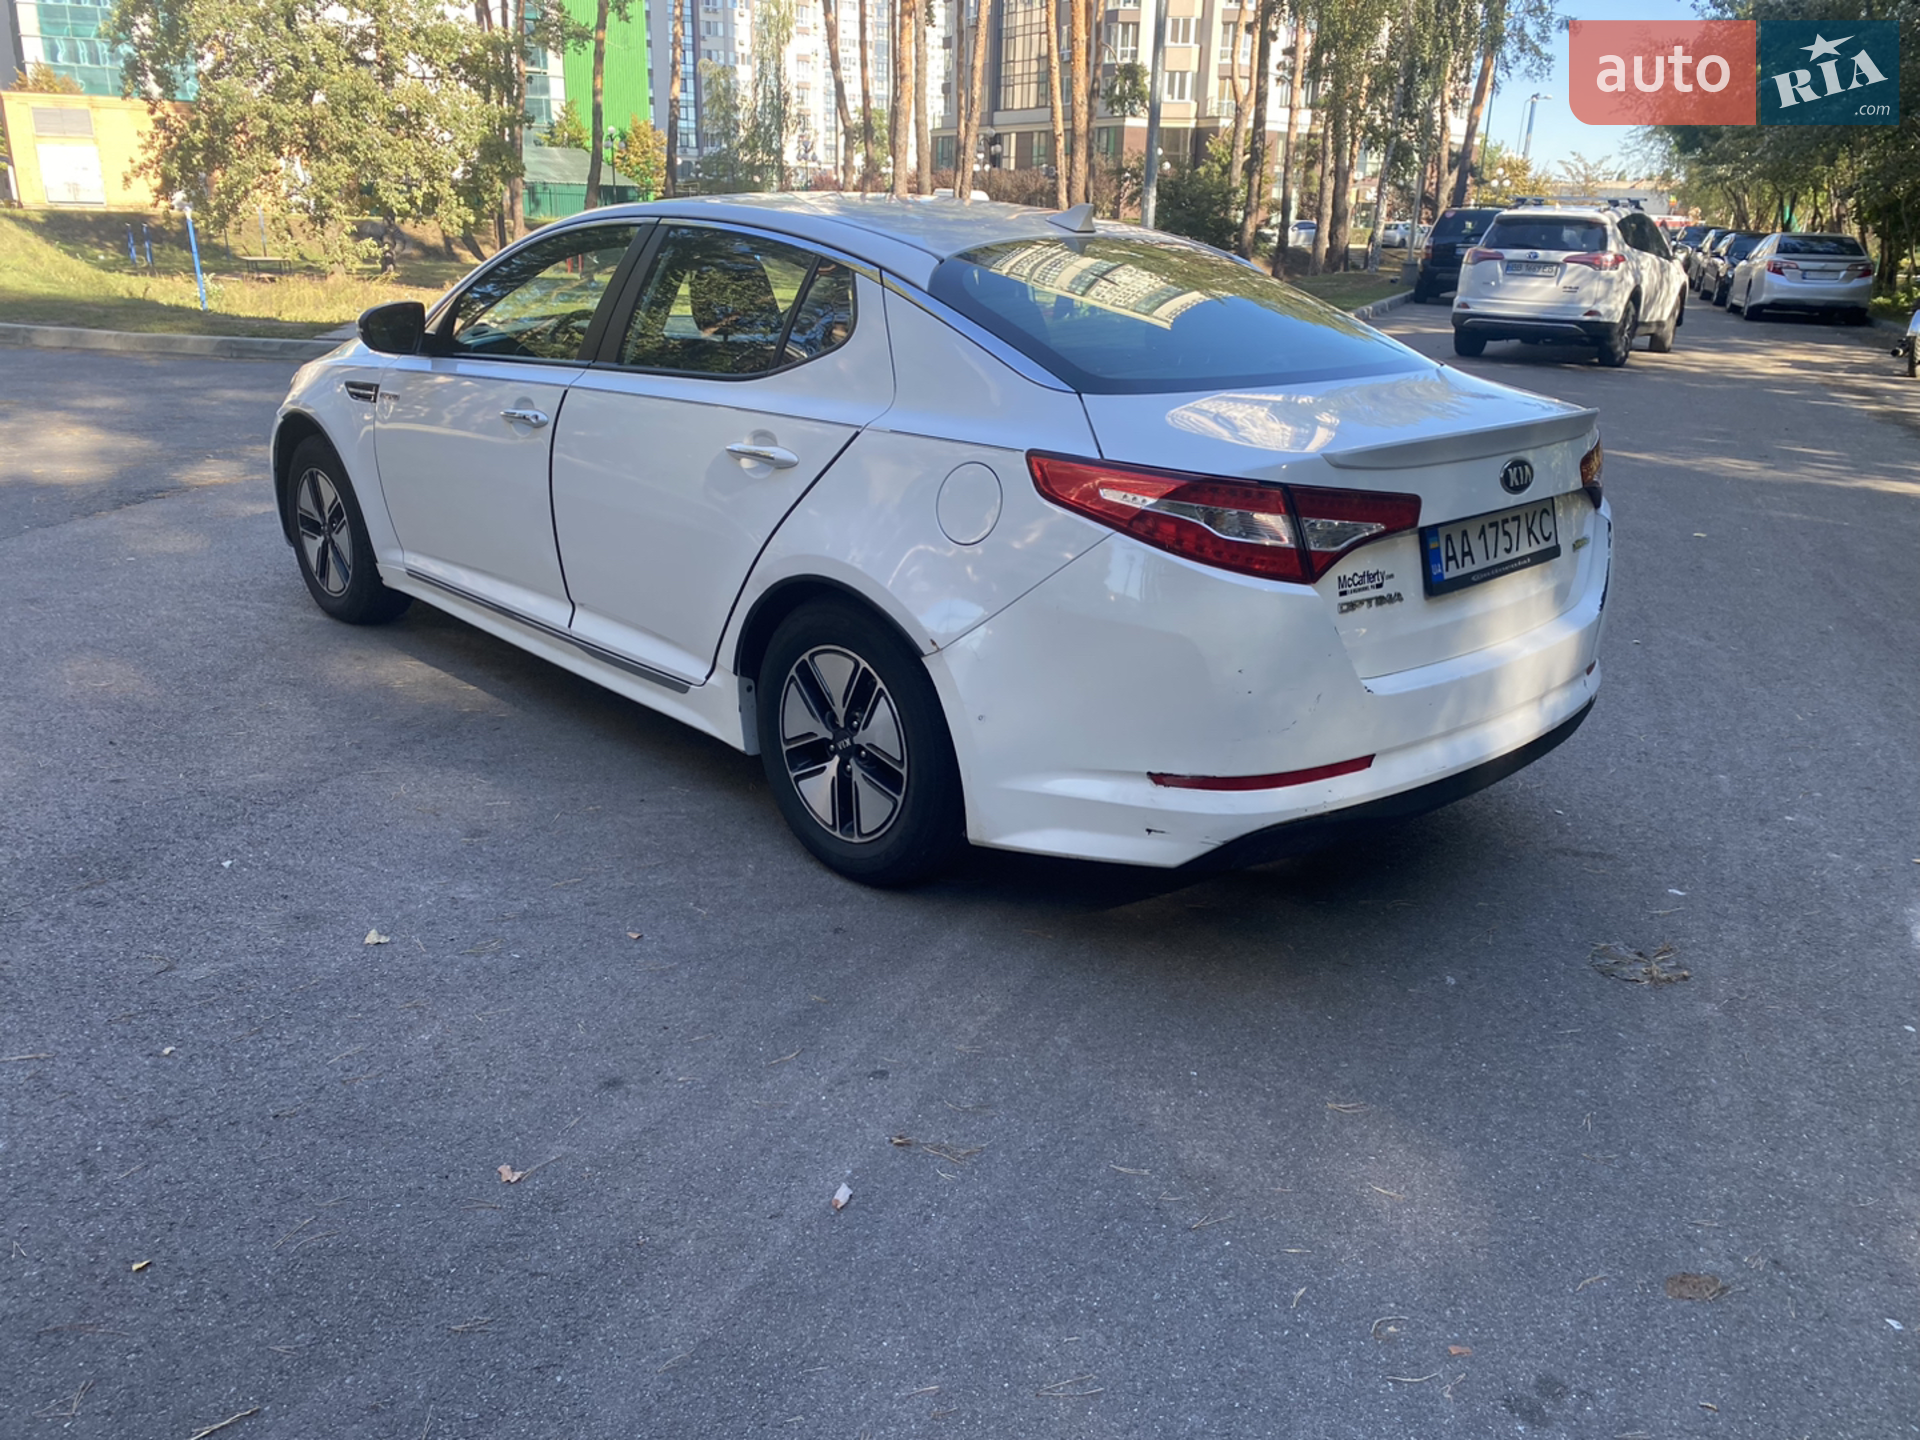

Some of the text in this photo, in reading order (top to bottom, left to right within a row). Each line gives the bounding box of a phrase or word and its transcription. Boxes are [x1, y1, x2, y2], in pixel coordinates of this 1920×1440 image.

[1508, 465, 1532, 488] KIA
[1445, 508, 1553, 572] AA 1757 KC
[1431, 563, 1442, 576] UA
[1337, 591, 1404, 615] OPTIMA
